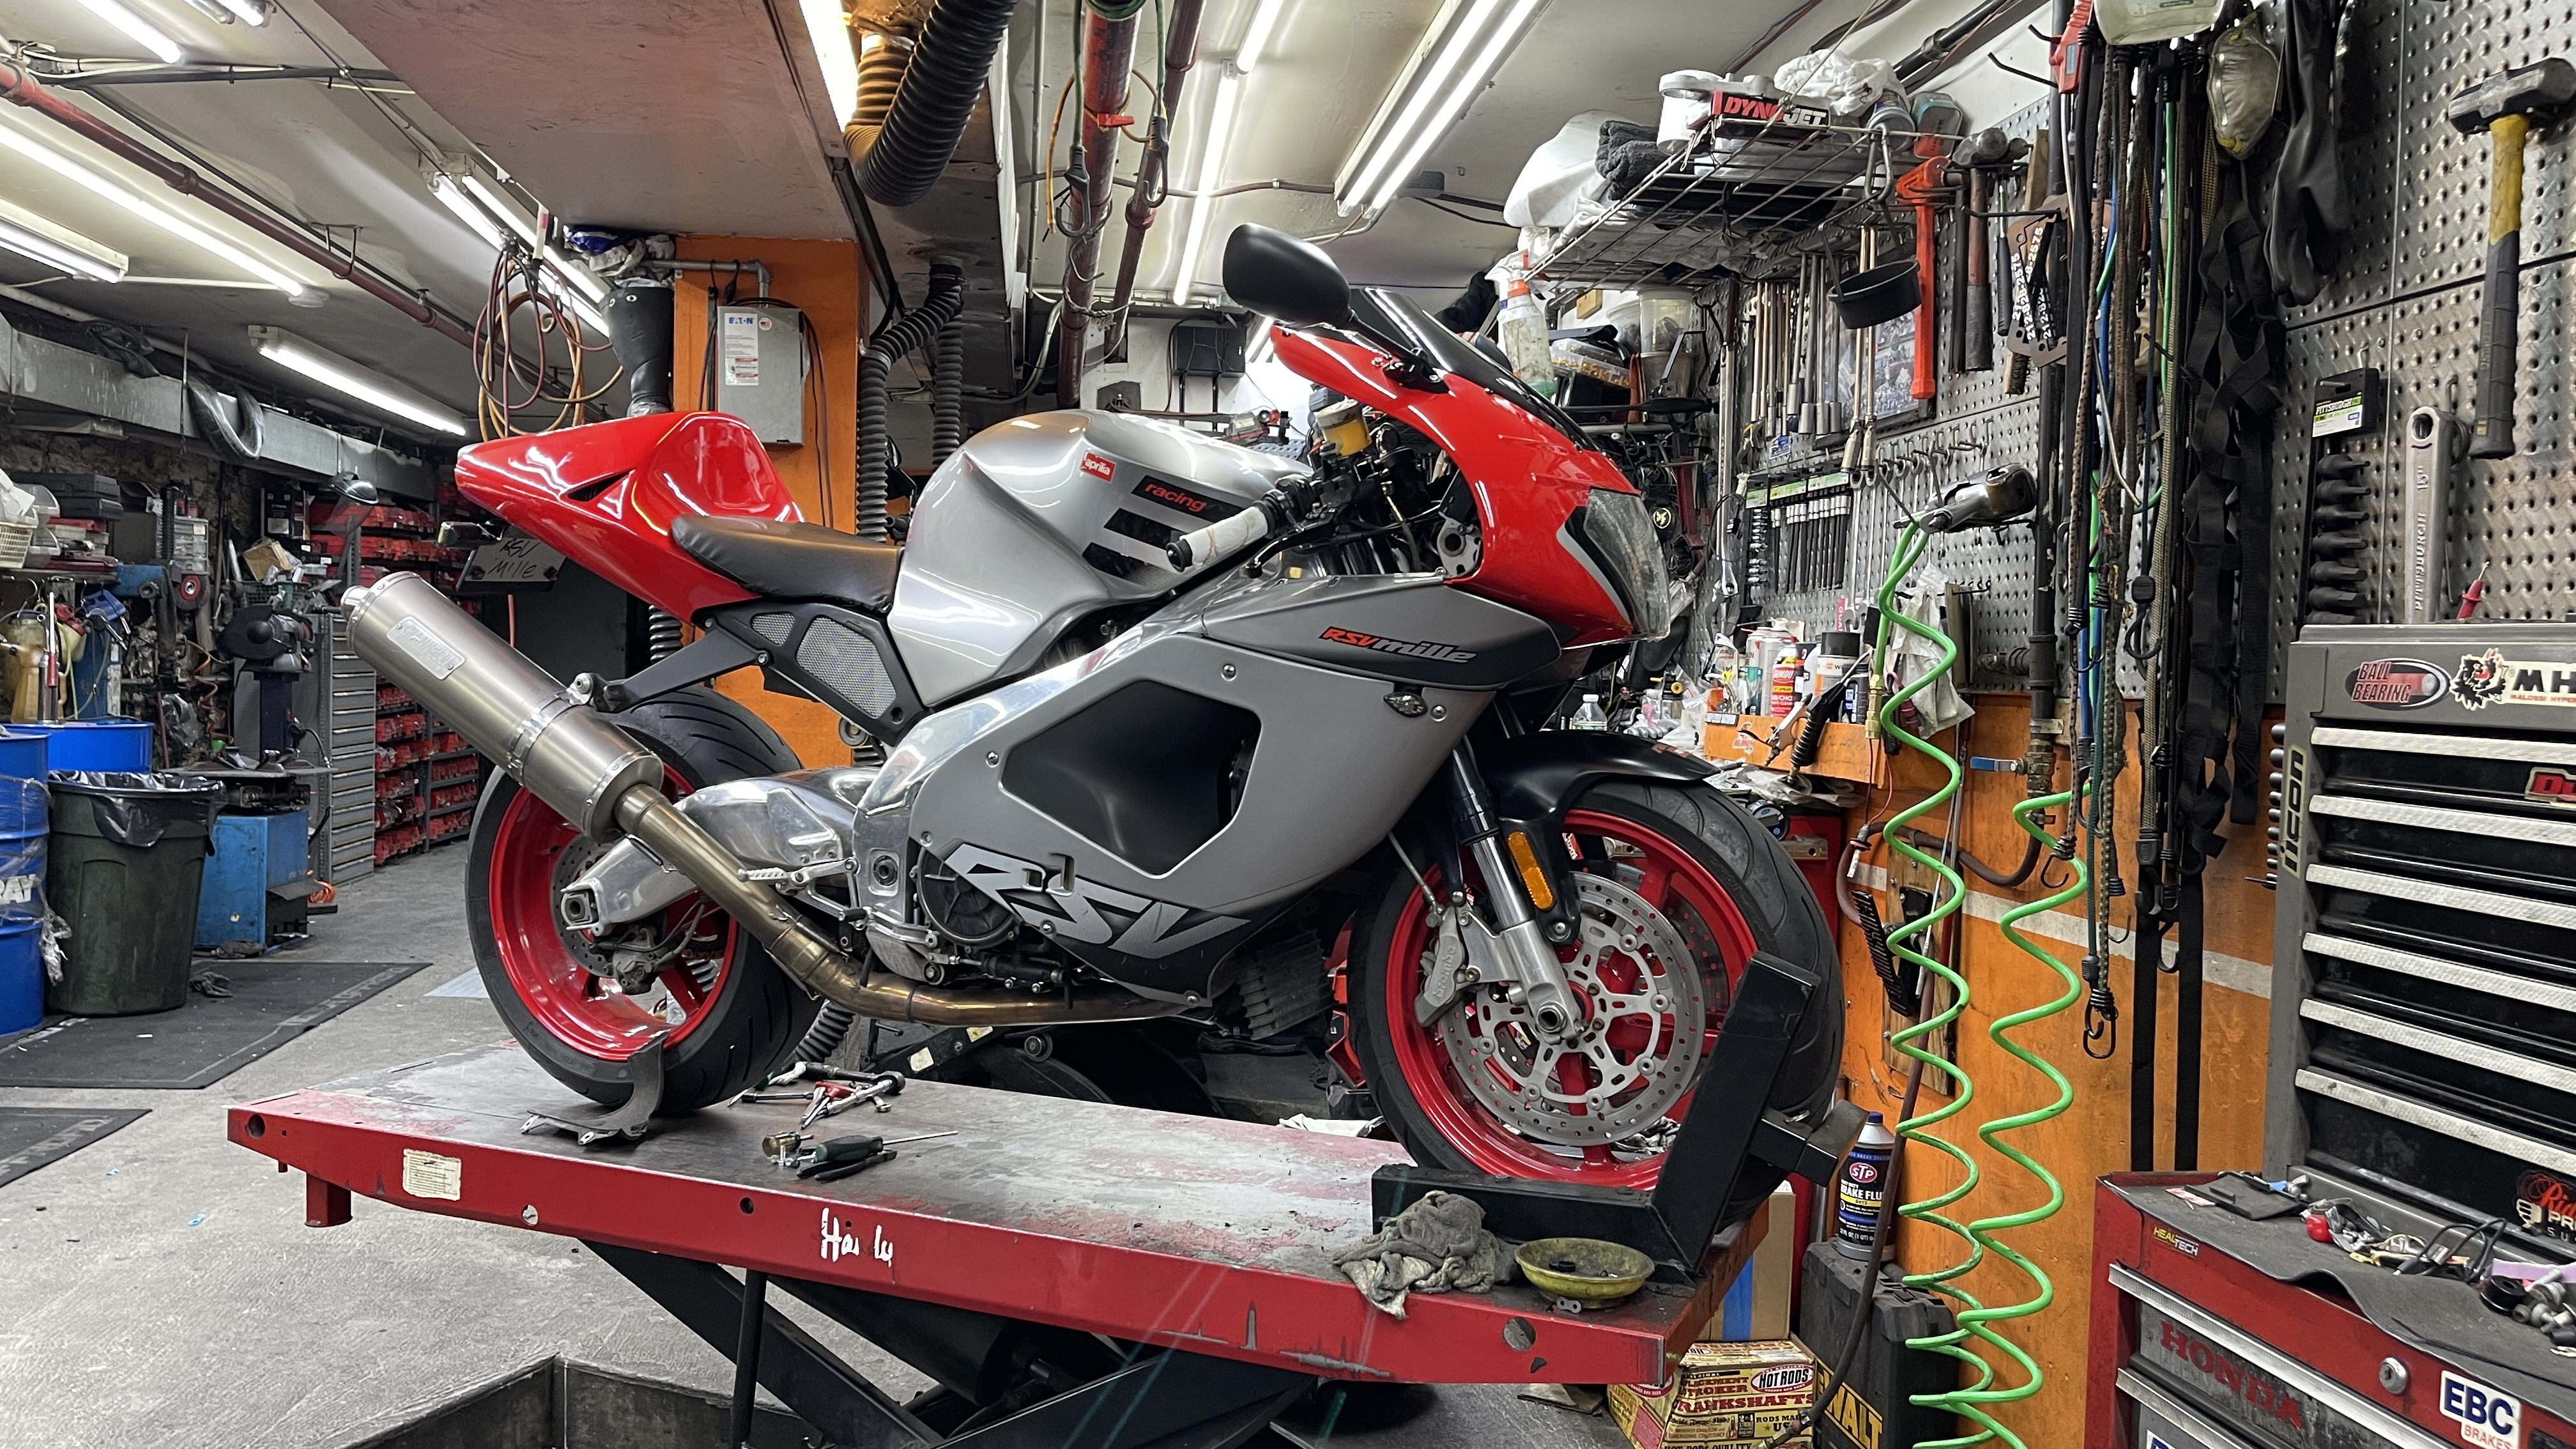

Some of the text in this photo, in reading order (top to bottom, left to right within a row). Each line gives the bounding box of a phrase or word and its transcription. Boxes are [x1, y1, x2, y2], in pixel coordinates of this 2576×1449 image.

[1085, 457, 1111, 476] aprilia
[1144, 483, 1207, 512] racing
[2415, 512, 2426, 611] PITTSBURGH
[2357, 662, 2391, 681] BALL
[2352, 684, 2411, 703] BEARING
[945, 843, 1252, 959] RSV
[1852, 1165, 1874, 1180] STP
[1865, 1190, 1882, 1200] FLU
[1759, 1368, 1809, 1389] HOT RODS
[2159, 1319, 2303, 1431] HONDA
[2444, 1377, 2515, 1436] EBC
[1773, 1422, 1790, 1432] US
[2464, 1424, 2512, 1449] BRAKES
